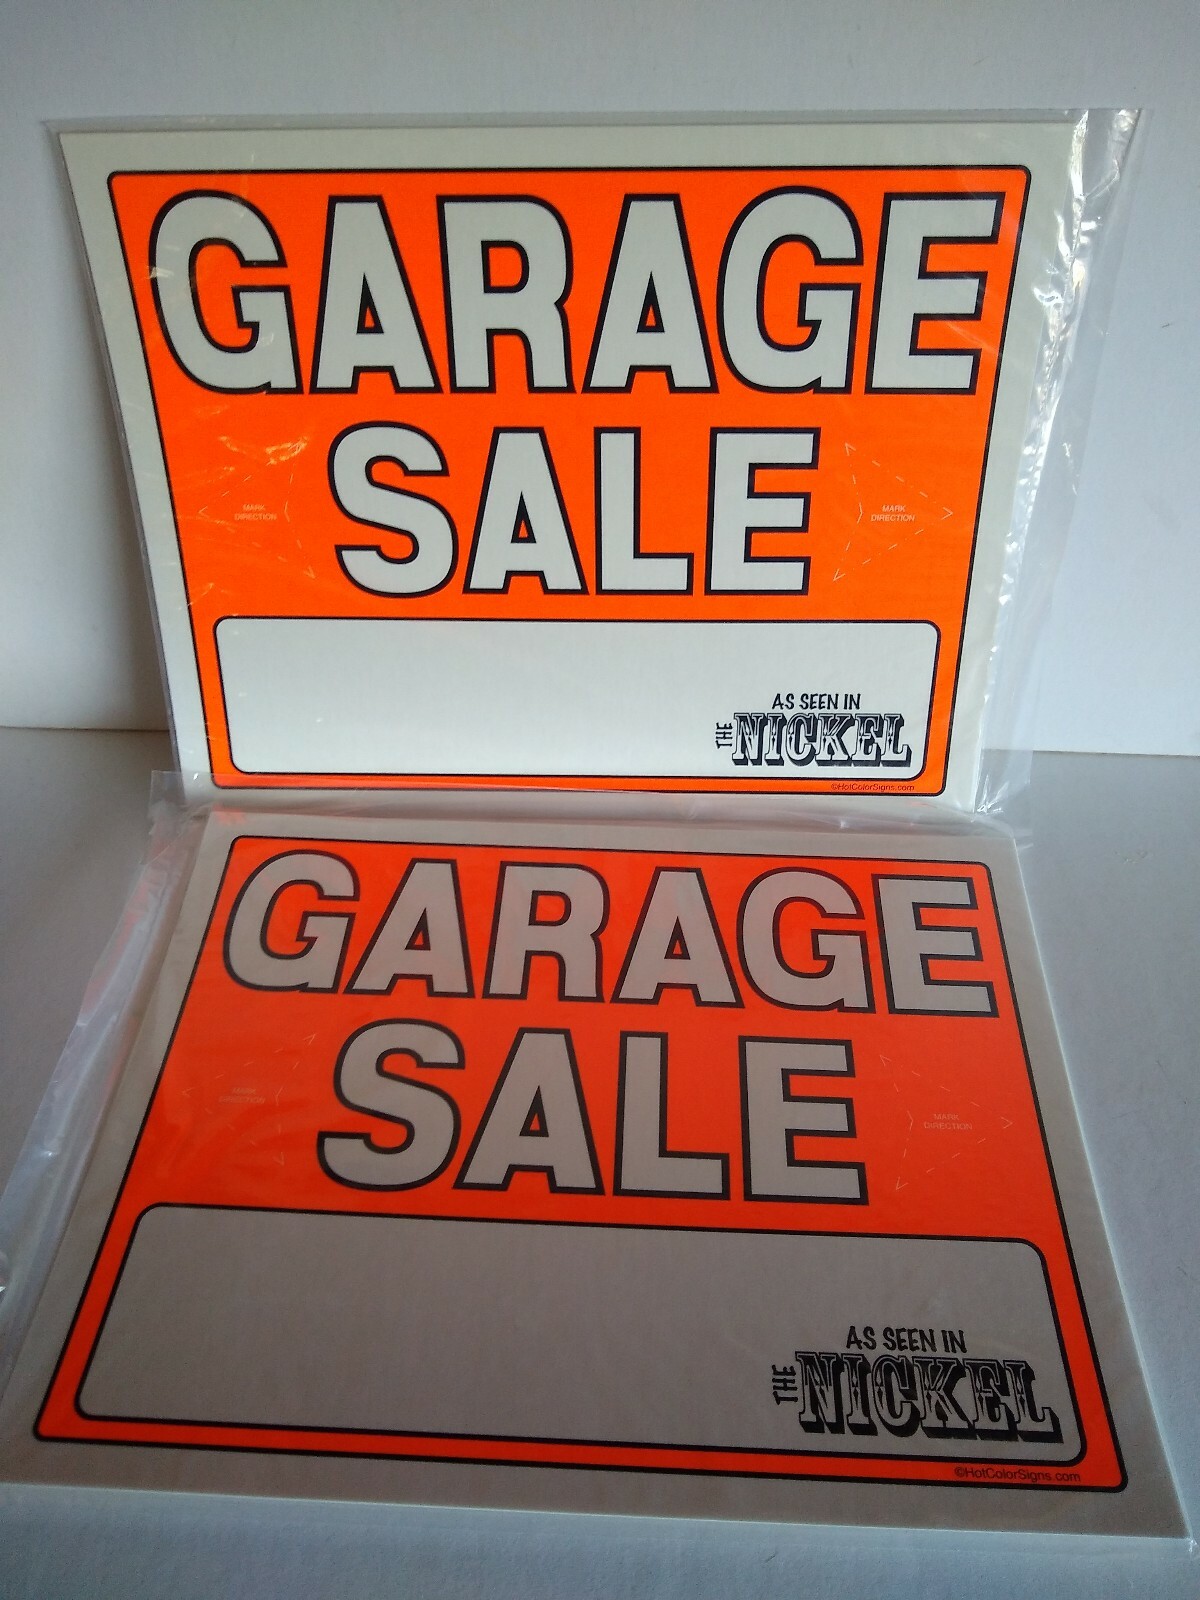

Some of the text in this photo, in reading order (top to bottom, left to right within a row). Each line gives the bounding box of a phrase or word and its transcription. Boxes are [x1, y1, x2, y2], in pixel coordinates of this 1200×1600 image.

[149, 185, 1007, 395] GARAGE
[327, 420, 821, 598] SALE
[870, 514, 916, 522] DIRECTION
[882, 504, 907, 512] MARK
[772, 693, 862, 710] AS SEEN IN
[715, 712, 912, 767] THE NICKEL
[222, 849, 1000, 1019] GARAGE
[316, 1018, 869, 1206] SALE
[923, 1121, 974, 1131] DIRECTION
[932, 1112, 960, 1121] MARK
[846, 1325, 968, 1354] AS SEEN IN
[771, 1350, 1065, 1444] THE NICKEL
